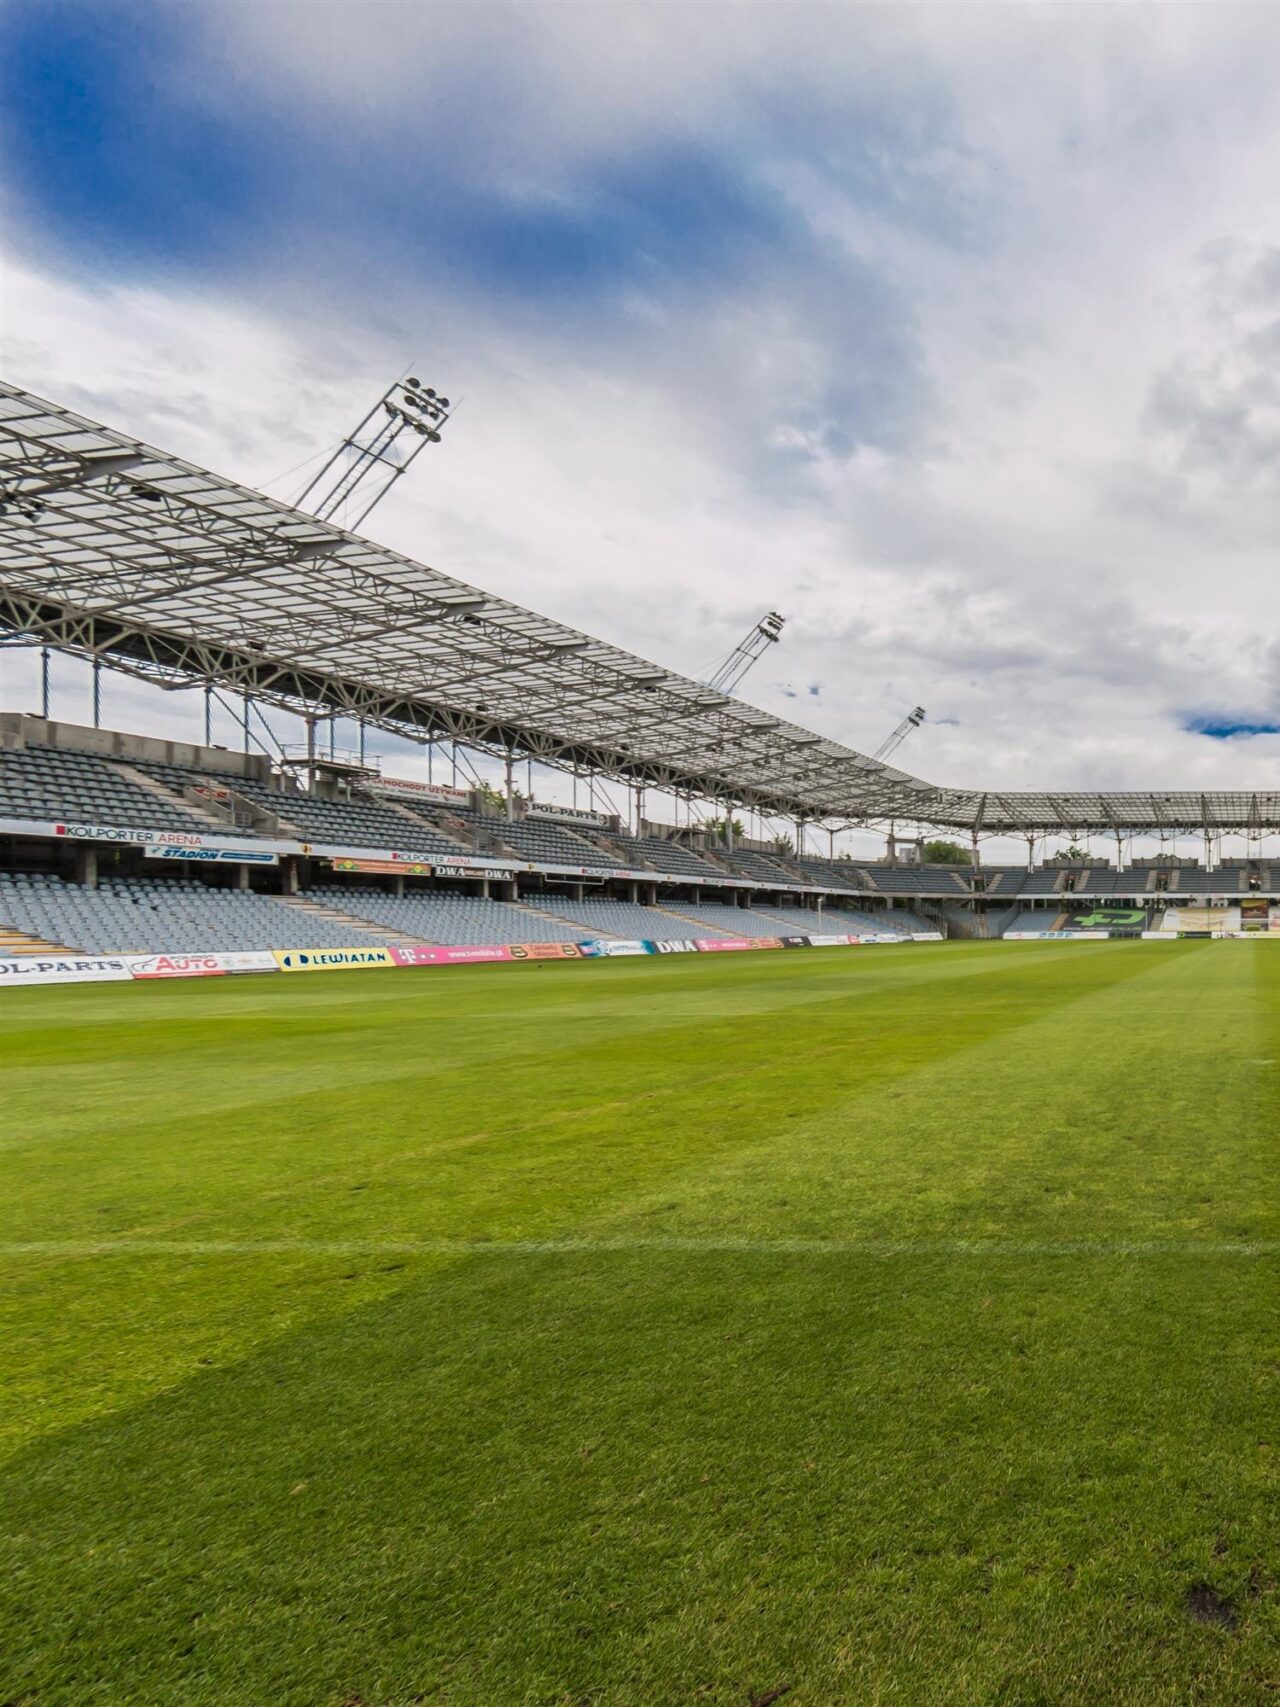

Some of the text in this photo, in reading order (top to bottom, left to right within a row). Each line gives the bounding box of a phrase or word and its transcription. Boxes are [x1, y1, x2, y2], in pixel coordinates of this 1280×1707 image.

[532, 803, 598, 820] POL-PARTS
[66, 827, 203, 845] KOLPORTER ARENA
[162, 849, 218, 860] STADION
[397, 853, 472, 865] KOLPORTER ARENA
[436, 865, 465, 877] DWA
[485, 869, 511, 879] DWA
[656, 941, 698, 953] DWA
[156, 956, 218, 971] AUTO
[313, 953, 386, 965] LEWIATAN
